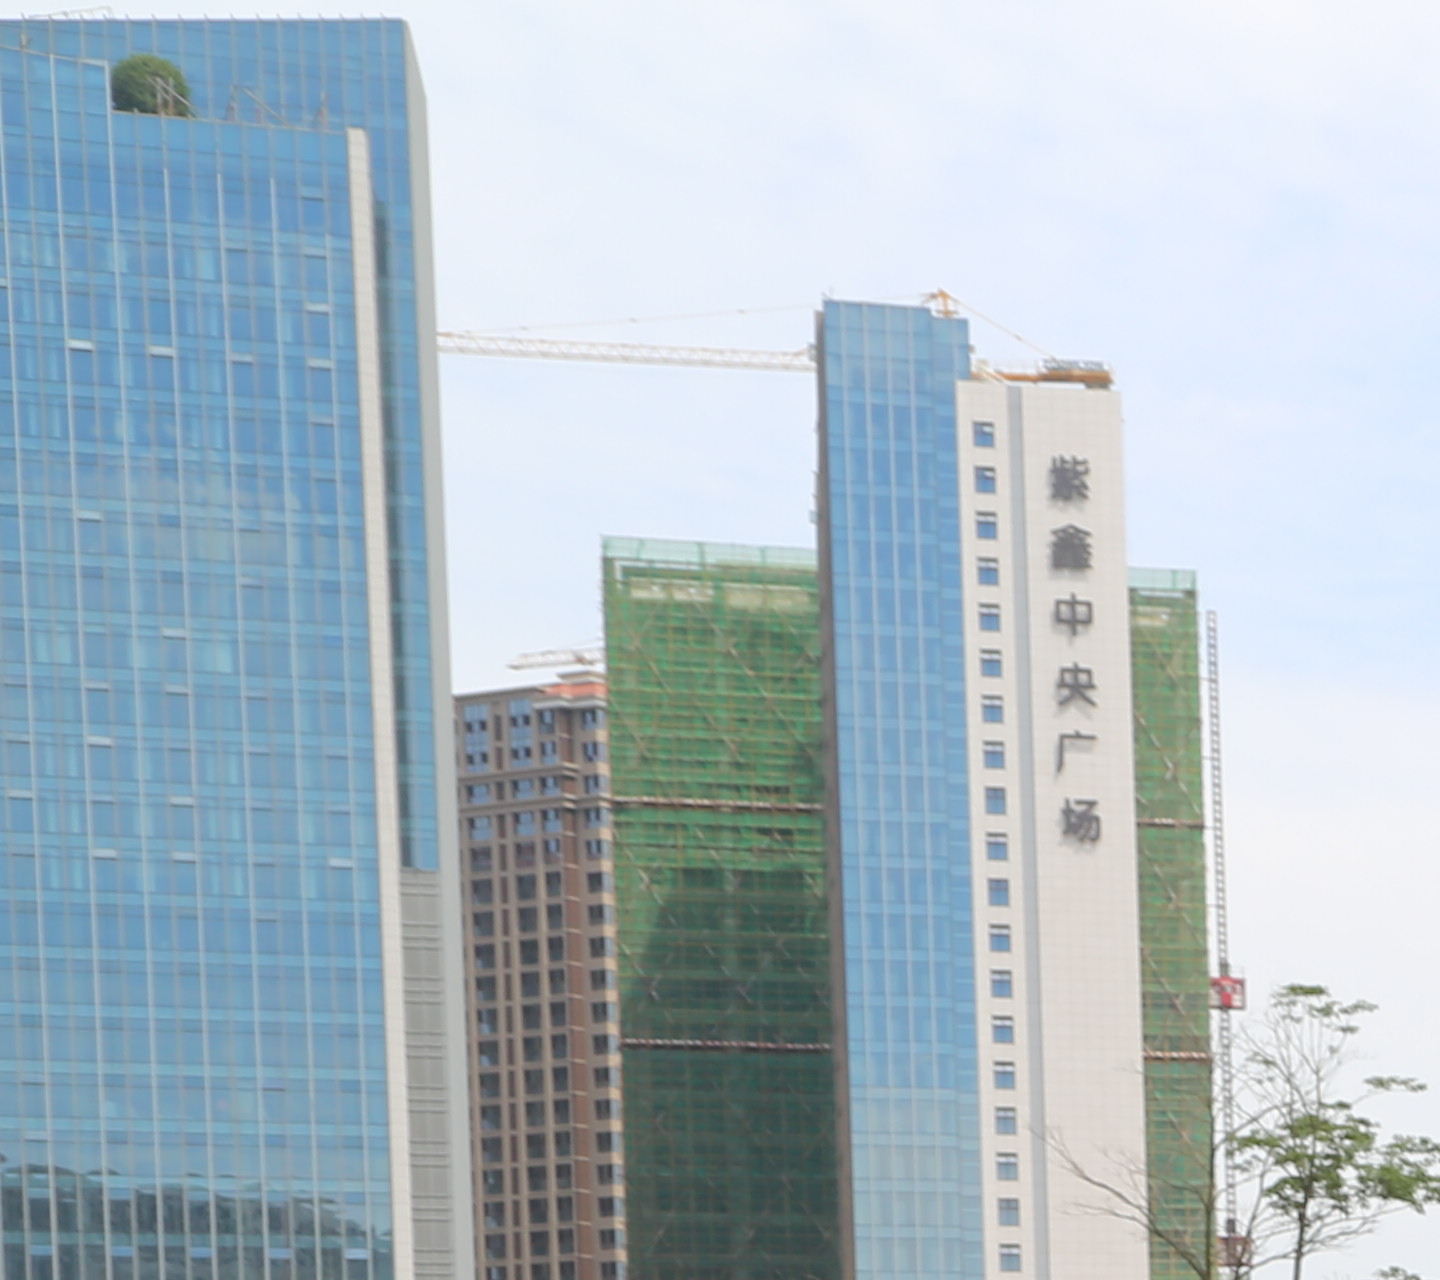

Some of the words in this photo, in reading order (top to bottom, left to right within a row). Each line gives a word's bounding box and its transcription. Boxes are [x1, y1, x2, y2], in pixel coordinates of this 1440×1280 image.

[1049, 453, 1102, 844] 紫鑫中央广场
